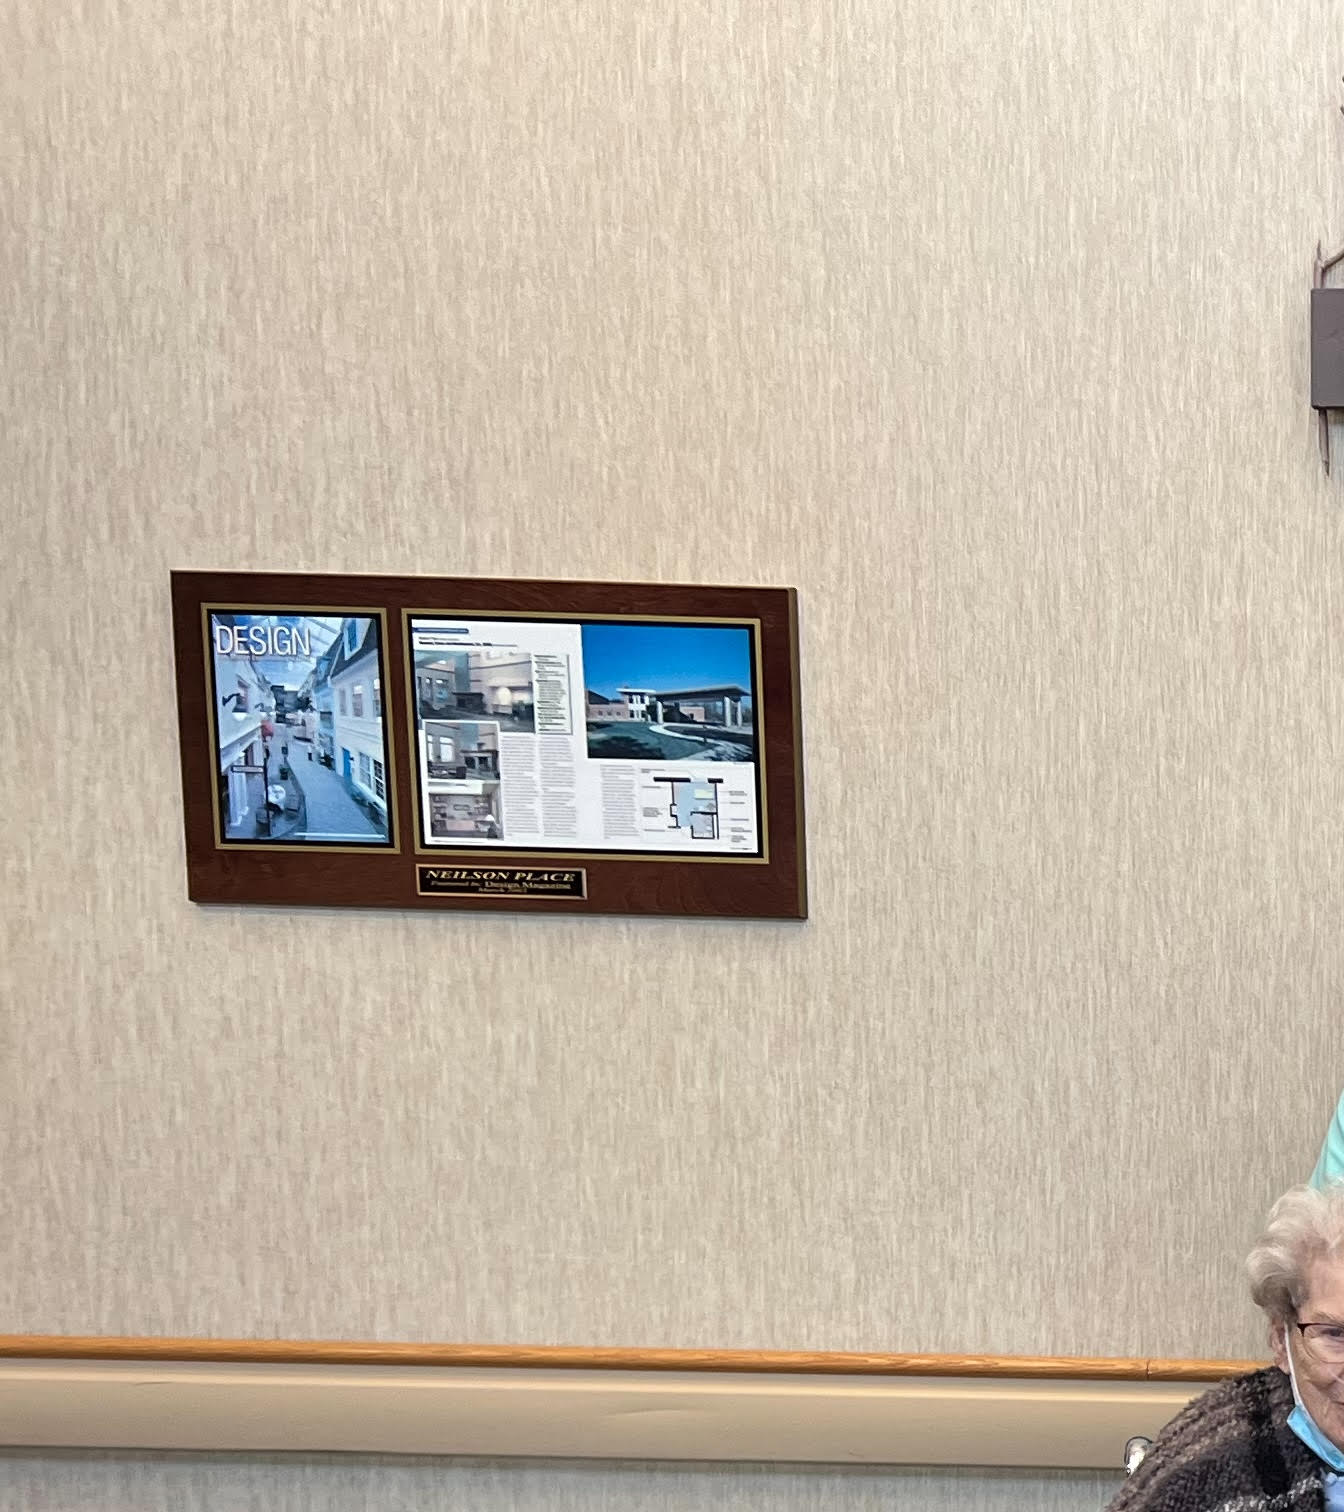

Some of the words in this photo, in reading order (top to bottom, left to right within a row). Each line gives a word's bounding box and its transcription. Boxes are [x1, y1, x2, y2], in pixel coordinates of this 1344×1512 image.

[216, 625, 311, 655] DESIGN
[426, 870, 509, 880] NEILSON
[514, 872, 575, 882] PLACE
